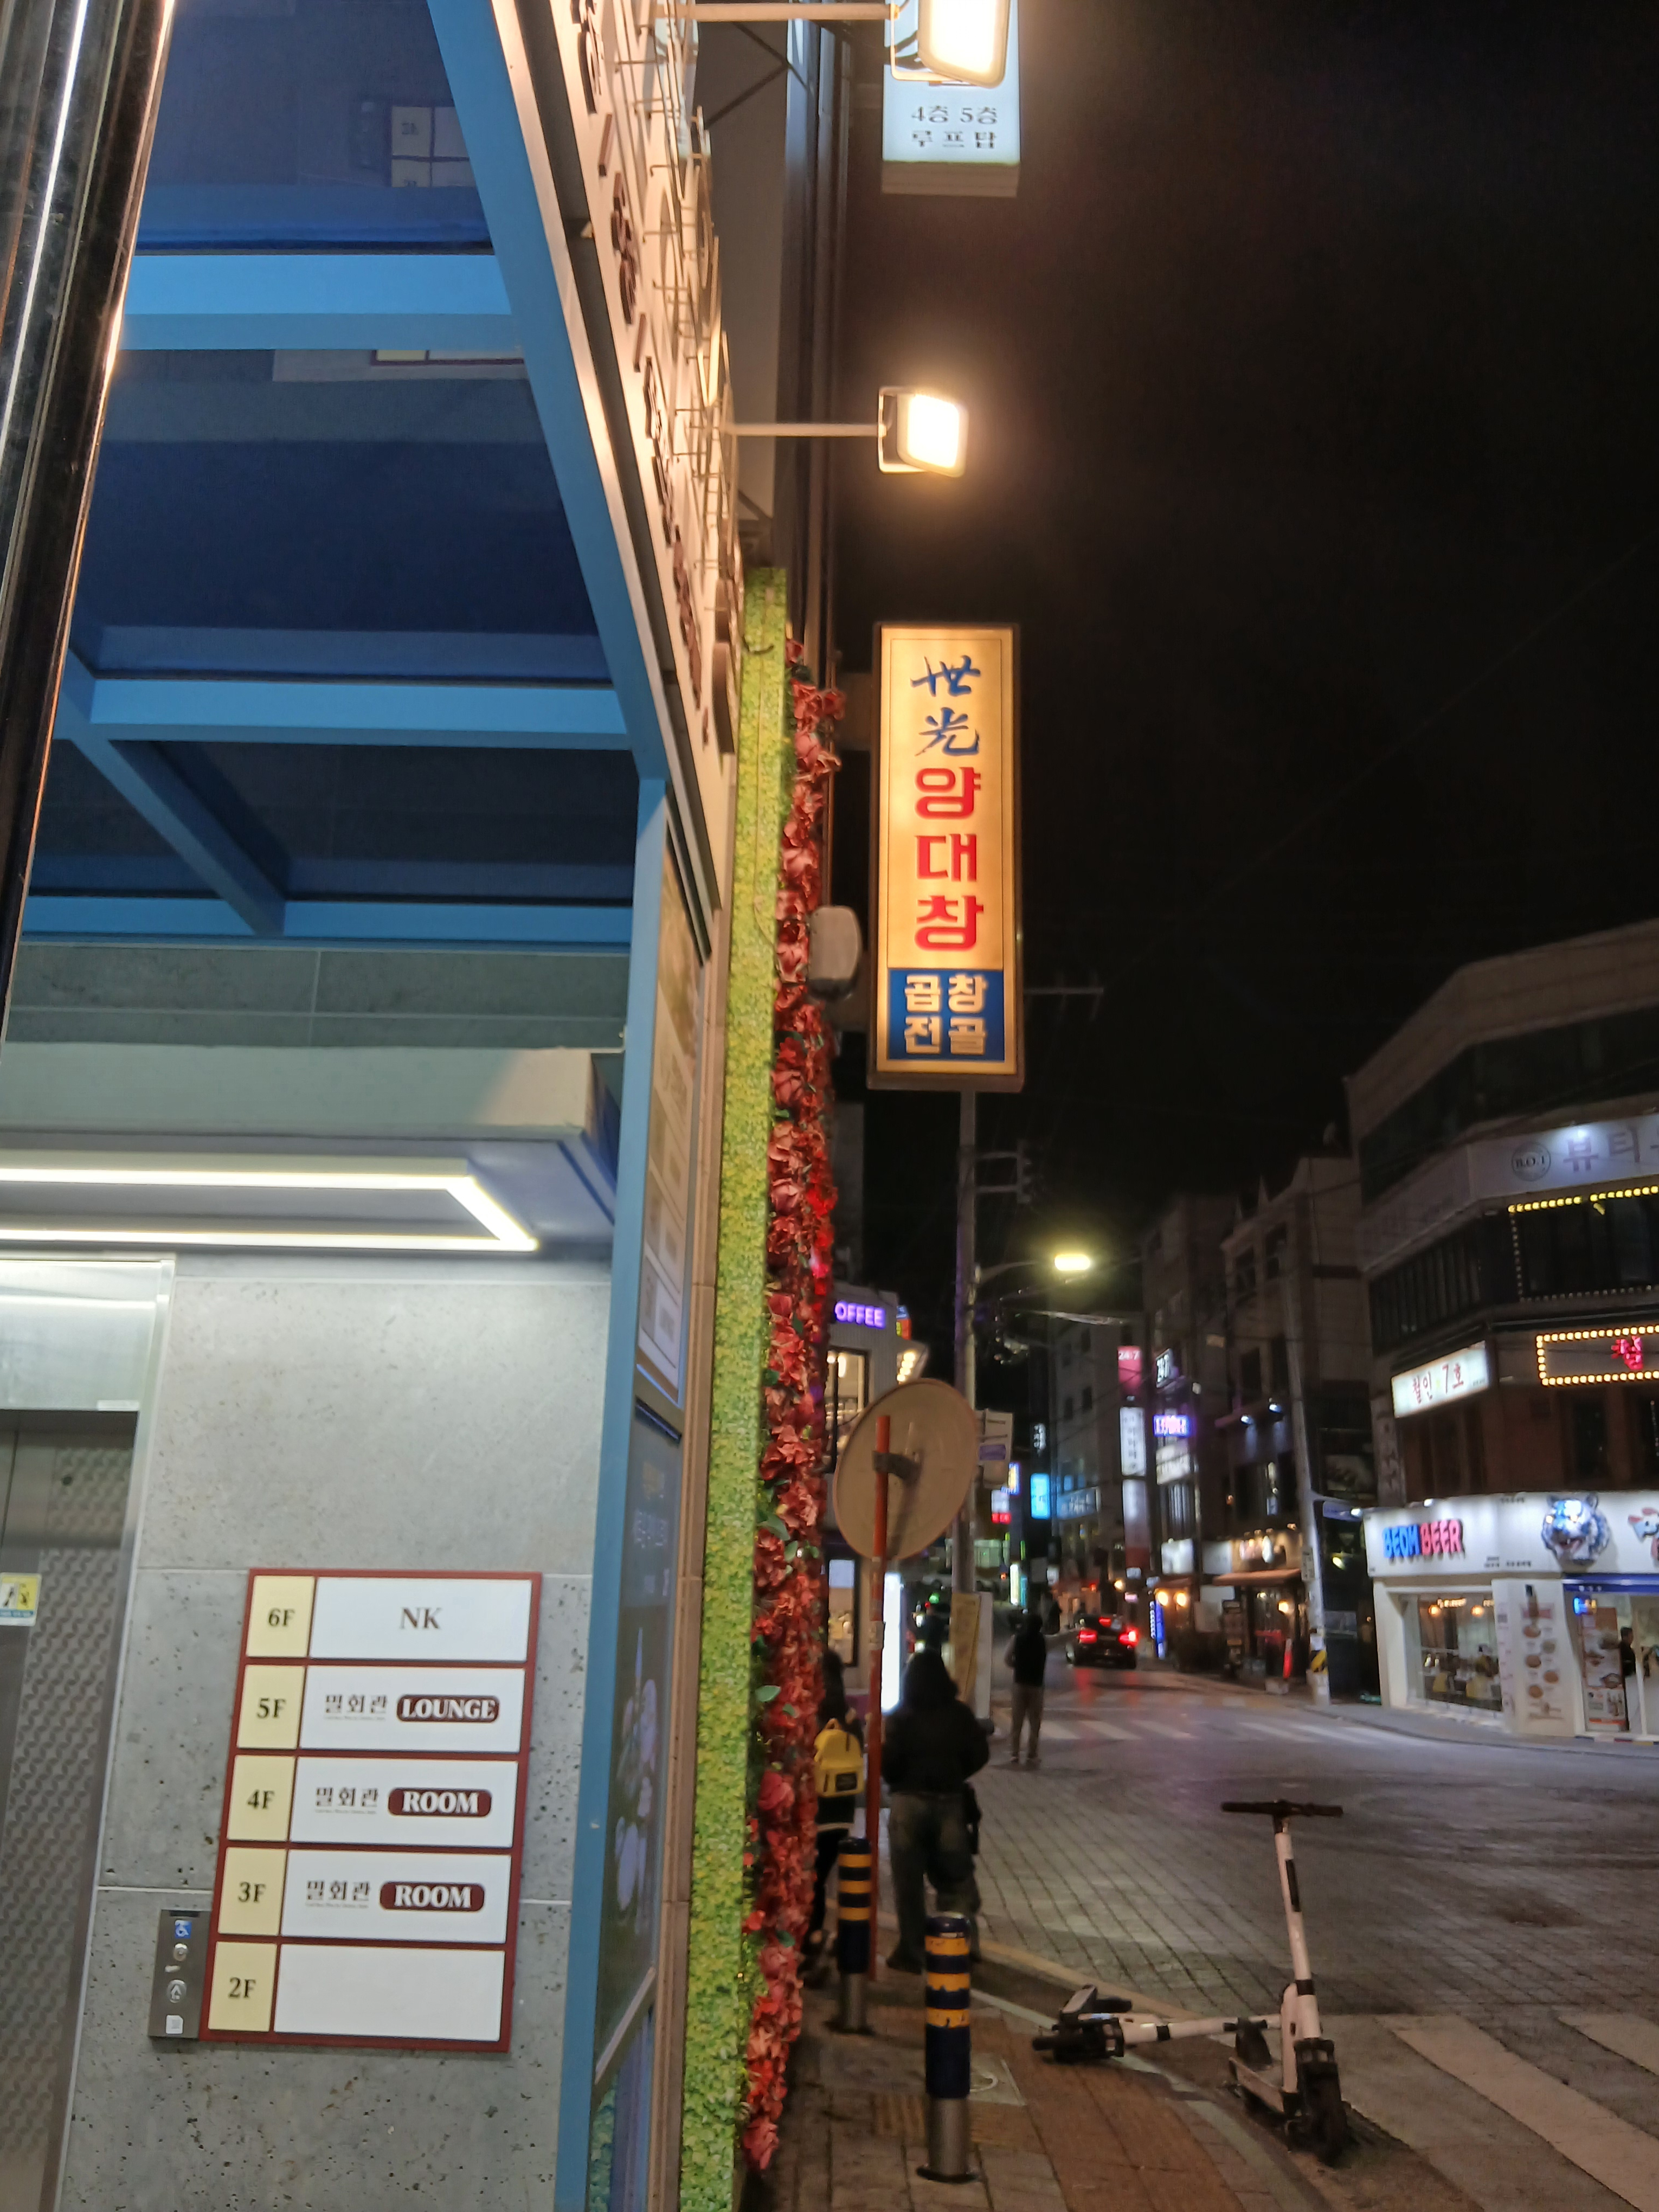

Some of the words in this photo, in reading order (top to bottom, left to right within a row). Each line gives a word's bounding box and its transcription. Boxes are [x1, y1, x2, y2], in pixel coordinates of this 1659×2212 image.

[960, 106, 998, 125] 5층
[914, 767, 984, 953] 양대창
[904, 974, 989, 1013] 곱창
[903, 1017, 987, 1056] 전골
[835, 1301, 885, 1328] OFFEE
[1383, 1525, 1420, 1559] BEOM
[1420, 1519, 1463, 1556] BEER
[268, 1609, 295, 1627] 6F
[400, 1606, 442, 1630] NK
[256, 1698, 286, 1719] 5F
[401, 1698, 496, 1719] LOUNGE
[247, 1790, 275, 1810] 4F
[402, 1791, 479, 1815] ROOM
[238, 1882, 266, 1902] 3F
[395, 1884, 472, 1908] ROOM
[228, 1977, 257, 1999] 2F
